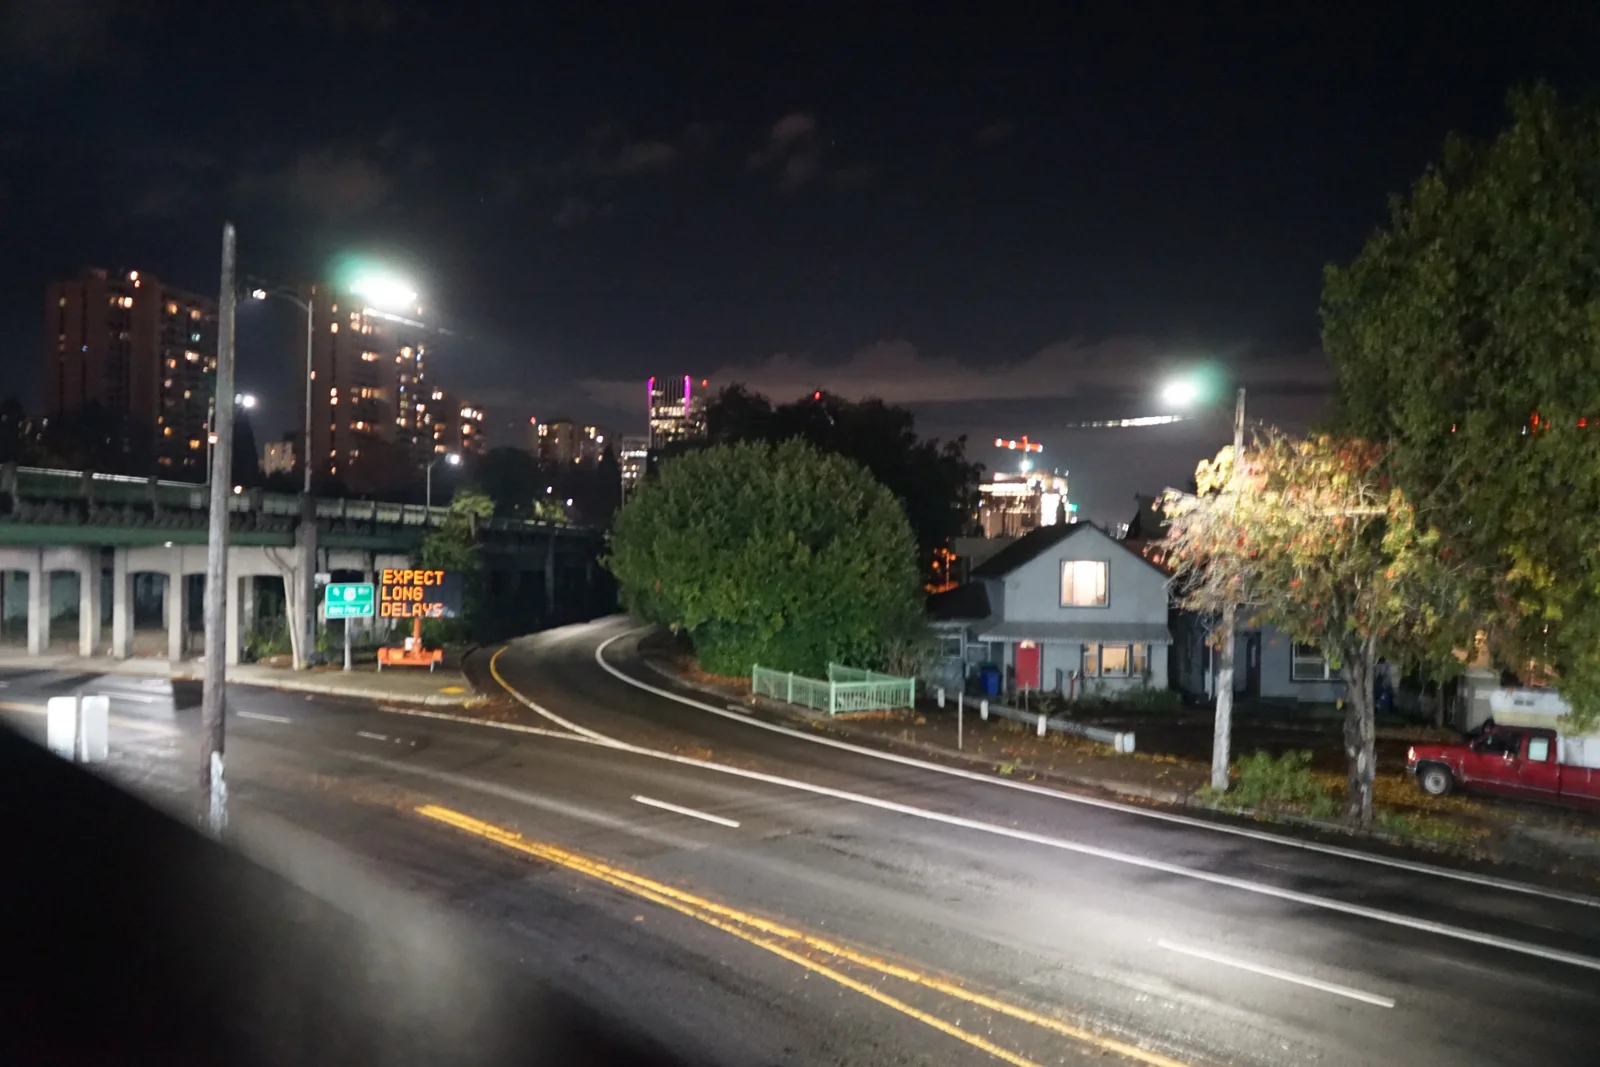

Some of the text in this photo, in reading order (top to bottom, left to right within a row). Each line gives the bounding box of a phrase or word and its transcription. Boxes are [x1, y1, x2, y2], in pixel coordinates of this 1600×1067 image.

[382, 569, 445, 585] EXPECT
[382, 585, 424, 601] LONG
[381, 602, 443, 617] DELAYS
